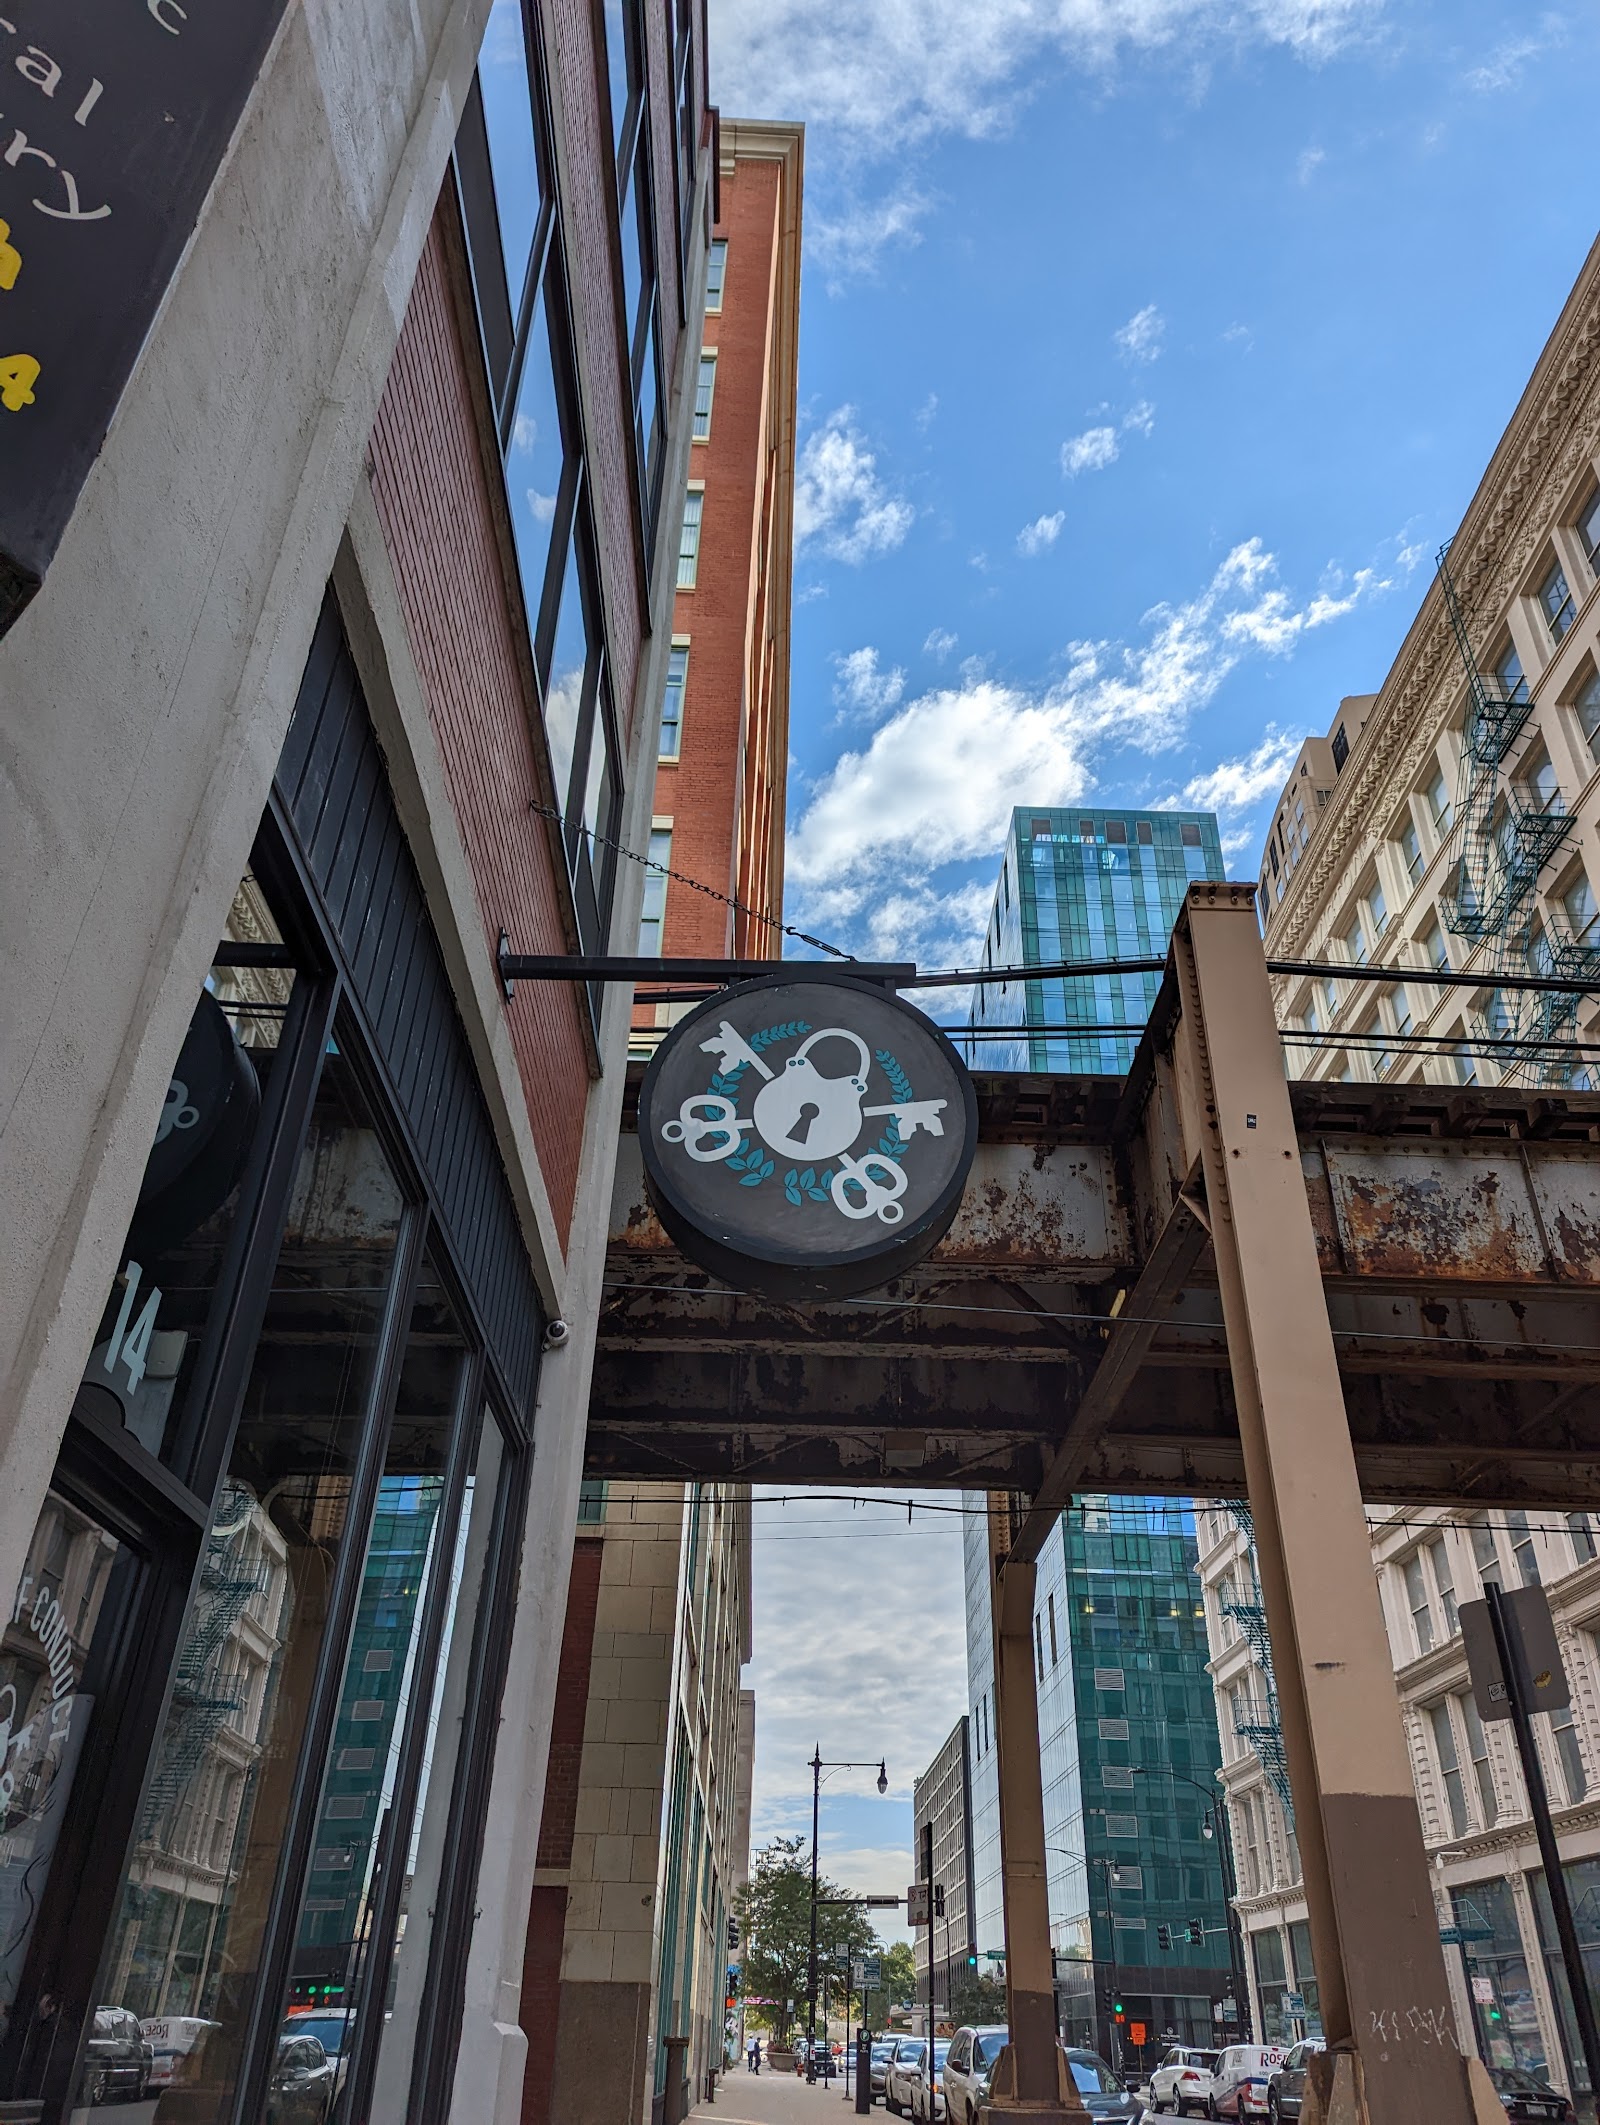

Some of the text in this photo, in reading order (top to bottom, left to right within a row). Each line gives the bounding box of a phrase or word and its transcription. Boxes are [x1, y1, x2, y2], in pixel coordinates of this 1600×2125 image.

[0, 18, 104, 126] al
[0, 118, 112, 220] ry
[104, 1260, 162, 1396] 14
[14, 1576, 75, 1744] F CONDUCT
